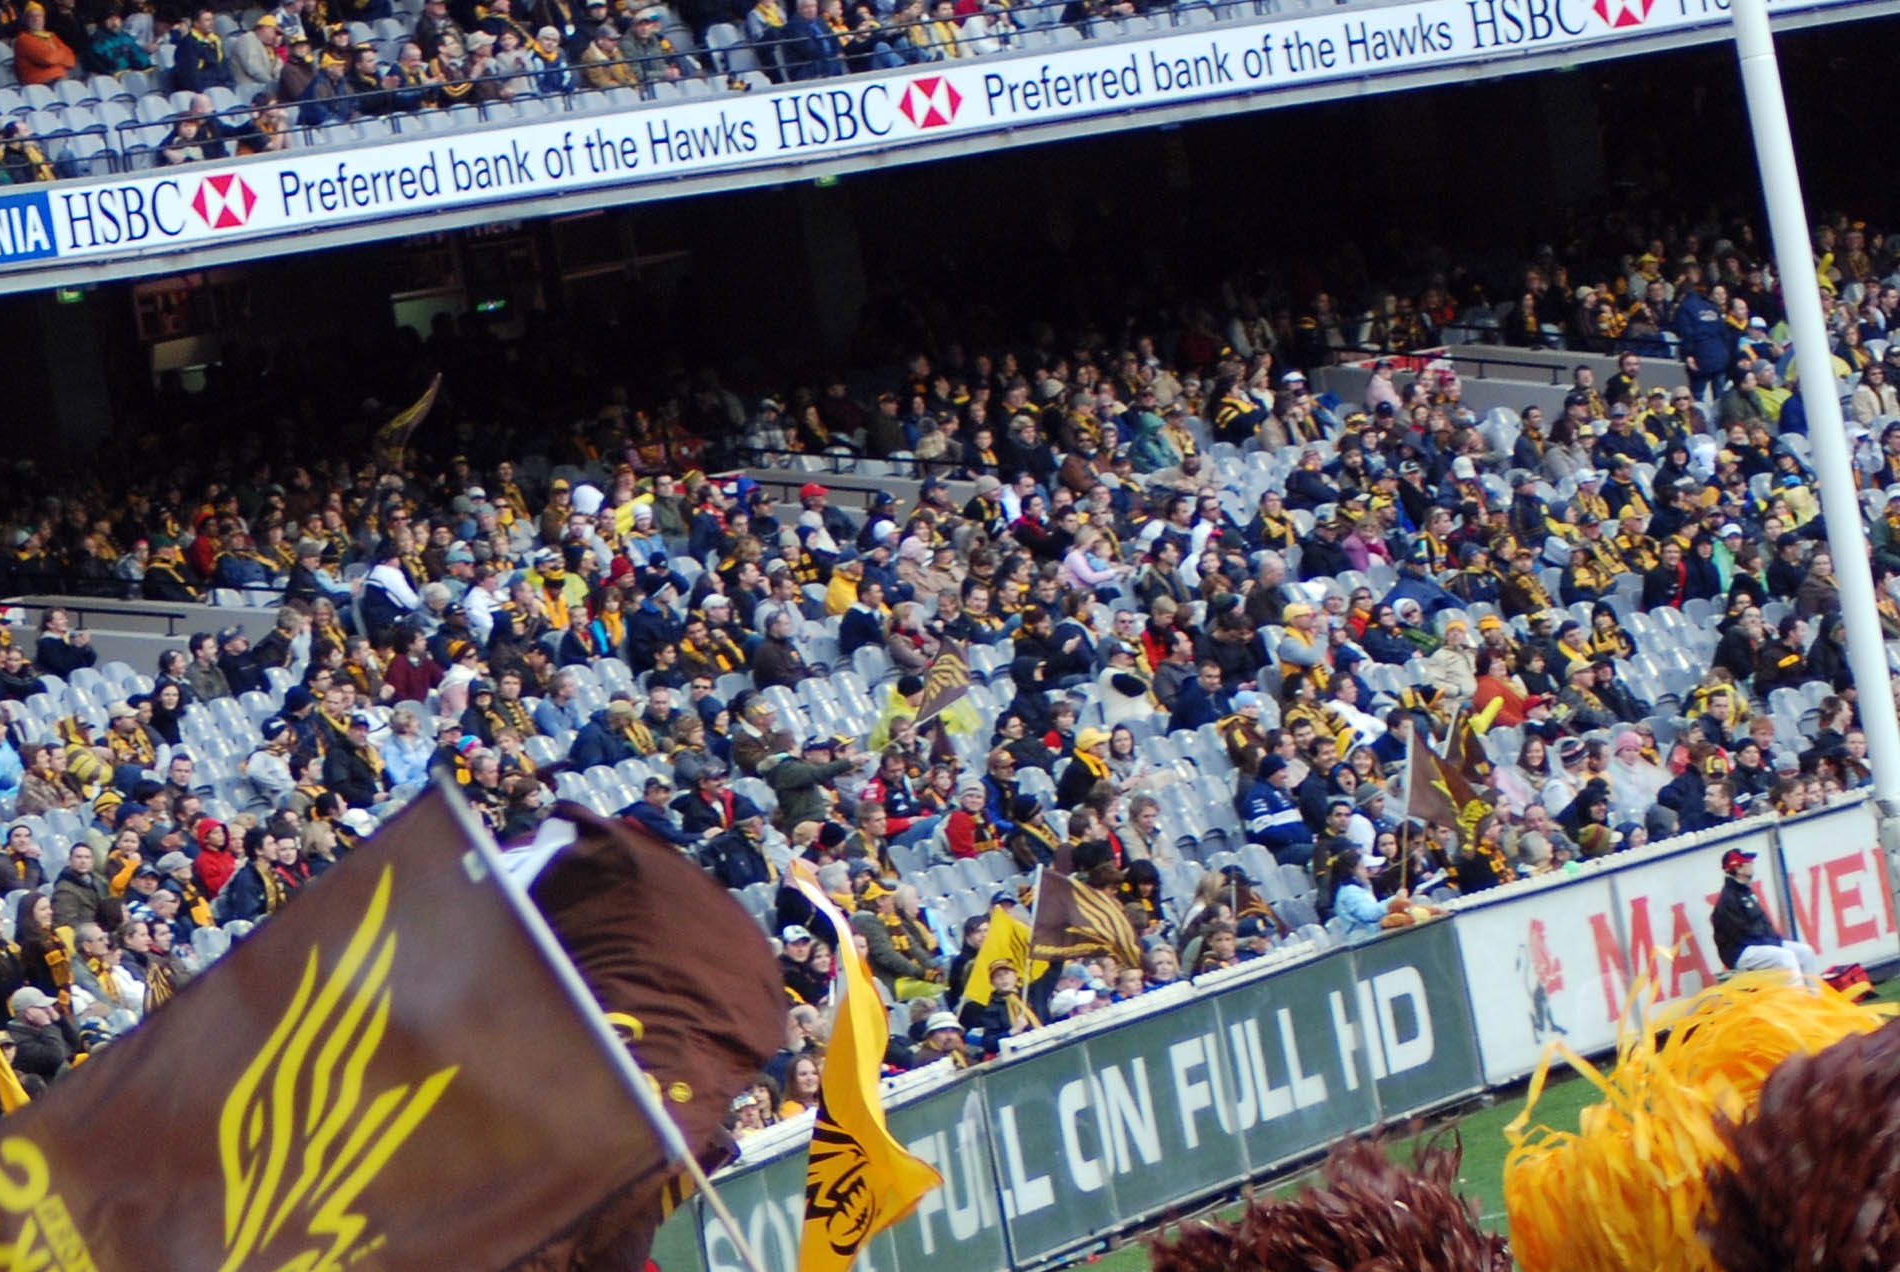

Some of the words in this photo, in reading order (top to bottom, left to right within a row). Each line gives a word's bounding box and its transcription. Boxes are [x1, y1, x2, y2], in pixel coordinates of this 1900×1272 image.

[771, 84, 894, 150] HSBC
[983, 52, 1142, 117] Preferred
[1151, 43, 1233, 92] bank
[1243, 34, 1275, 79] of
[1284, 31, 1337, 74] the
[1345, 14, 1454, 64] Hawks
[1466, 0, 1587, 49] HSBC
[61, 180, 187, 250] HSBC
[278, 151, 442, 218] Preferred
[449, 141, 535, 193] bank
[544, 131, 577, 180] of
[584, 129, 639, 174] the
[648, 111, 759, 165] Hawks
[1058, 1057, 1164, 1193] ON
[1169, 1007, 1330, 1150] FULL
[1329, 965, 1435, 1091] HD
